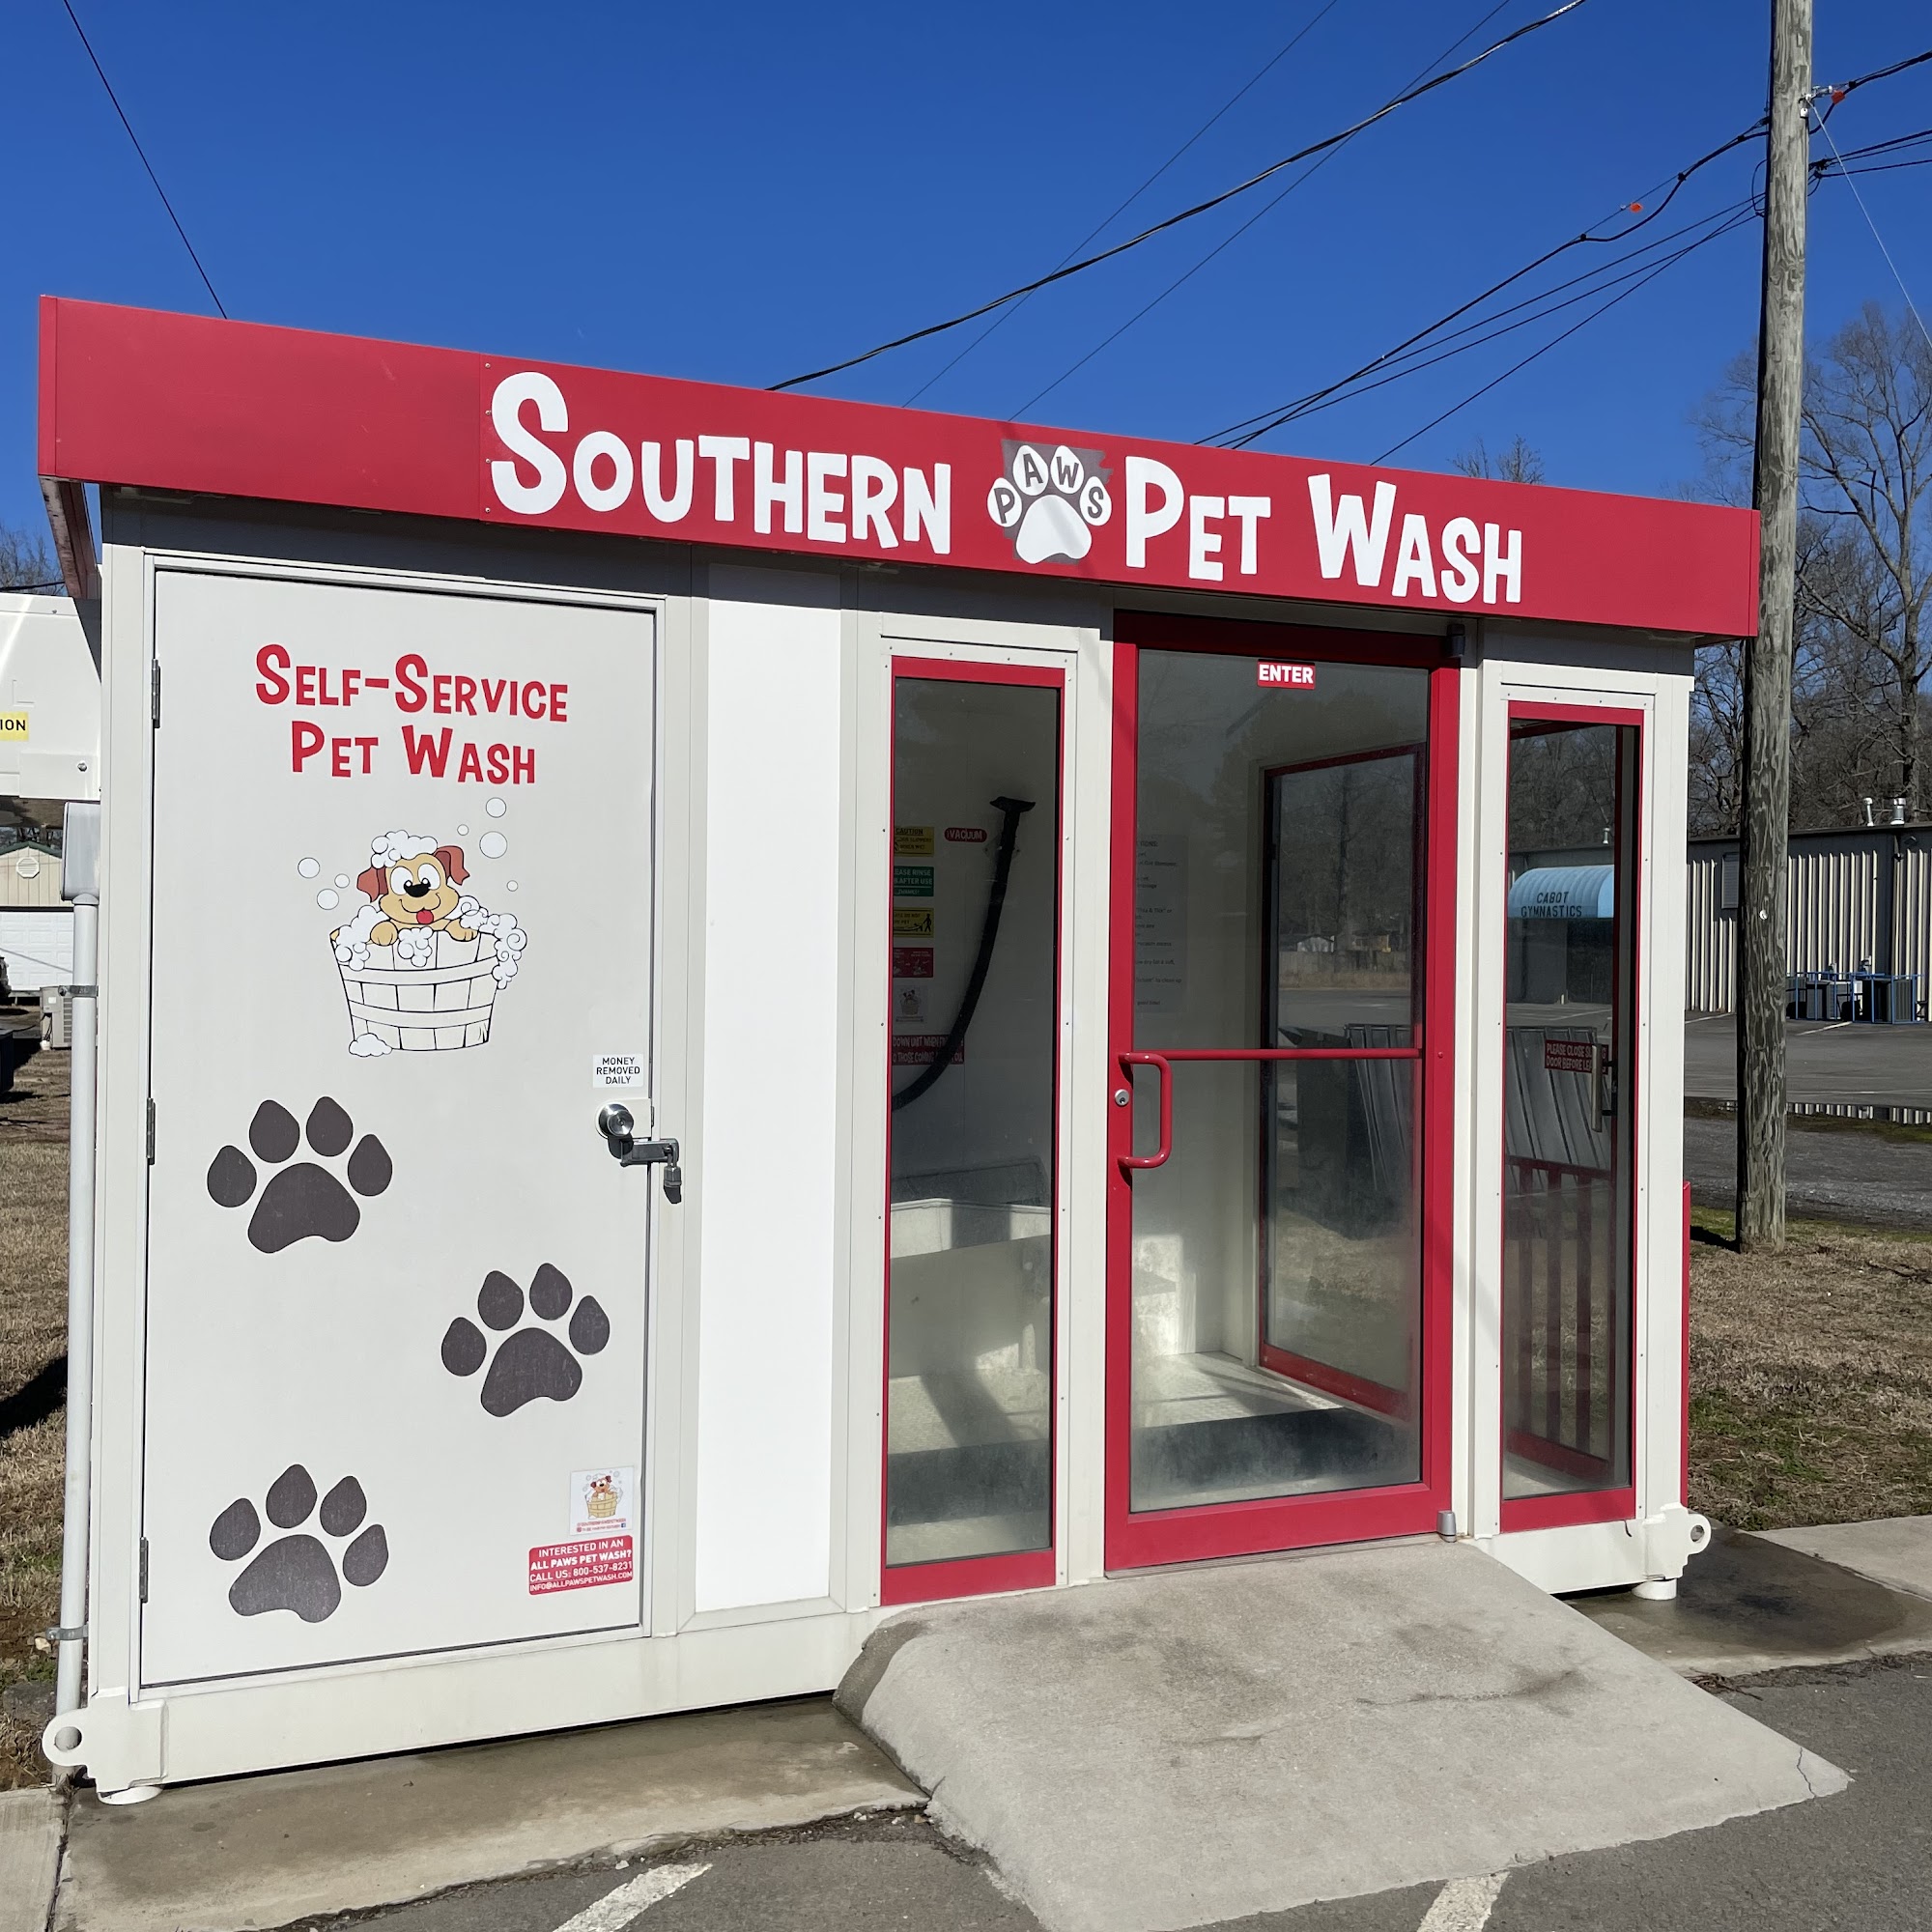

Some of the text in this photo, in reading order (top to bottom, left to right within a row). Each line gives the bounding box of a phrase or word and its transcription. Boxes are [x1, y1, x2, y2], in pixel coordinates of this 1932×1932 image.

[491, 371, 952, 555] SOUTHERN
[994, 452, 1104, 524] PAWS
[1124, 455, 1522, 605] PET WASH
[1258, 664, 1314, 685] ENTER
[292, 721, 535, 784] PET WASH
[1536, 892, 1570, 904] CABOT
[1520, 904, 1583, 918] GYMNASTICS
[1547, 1043, 1566, 1056] PLEASE
[1567, 1045, 1584, 1058] CLOSE
[596, 1066, 640, 1075] REMOVED
[602, 1057, 635, 1065] MONEY
[1547, 1056, 1561, 1068] DOOR
[1562, 1058, 1582, 1070] BEFORE
[605, 1075, 631, 1085] DAILY
[538, 1539, 624, 1558] INTERESTED IN AN
[530, 1549, 633, 1571] ALL PAWS PET WASH?
[529, 1571, 554, 1583] CALL
[573, 1561, 633, 1577] 800-537-8231
[529, 1571, 633, 1592] INFO@ALLPAWSPETWASH.COM
